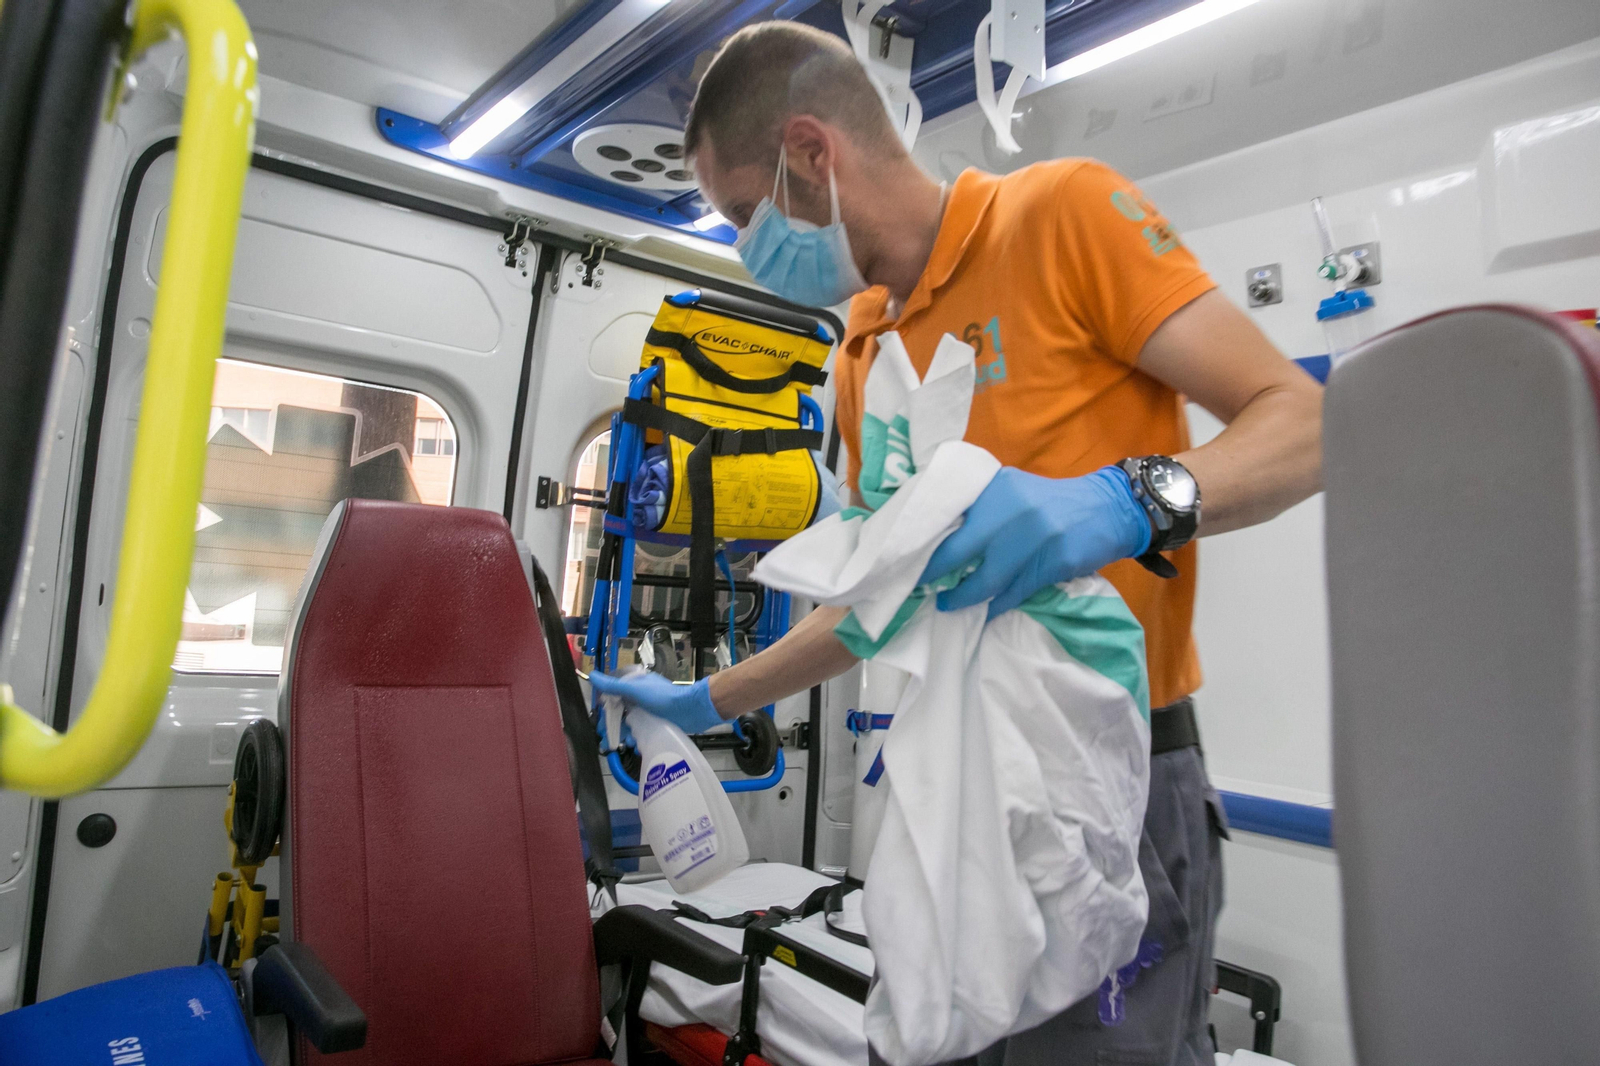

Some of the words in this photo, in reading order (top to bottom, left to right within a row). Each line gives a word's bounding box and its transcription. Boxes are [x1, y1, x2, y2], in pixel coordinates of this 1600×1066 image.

[701, 332, 741, 348] EVAC
[749, 344, 791, 360] CHAIR
[949, 316, 1002, 358] 61
[669, 767, 687, 781] Spray
[108, 1036, 146, 1066] NES
